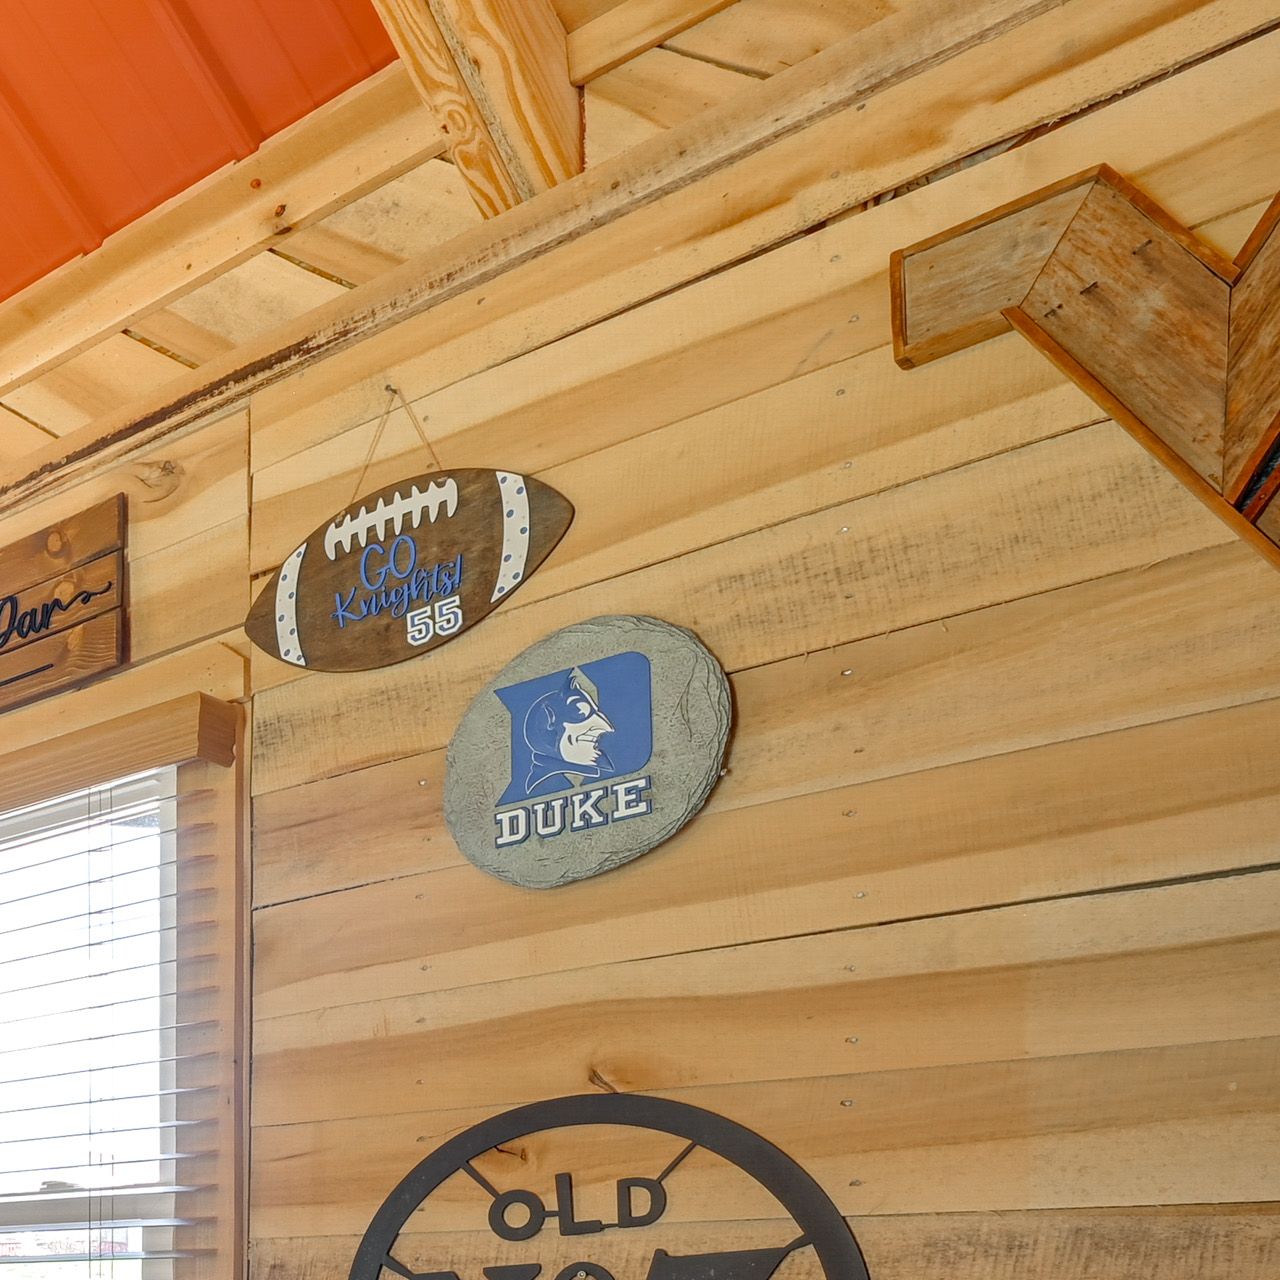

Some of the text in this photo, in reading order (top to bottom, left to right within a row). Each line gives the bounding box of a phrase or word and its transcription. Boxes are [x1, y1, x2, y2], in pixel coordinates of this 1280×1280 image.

[330, 553, 463, 628] Knights!
[361, 535, 416, 590] GO
[406, 595, 463, 647] 55
[493, 775, 652, 849] DUKE
[488, 1172, 667, 1241] OLD
